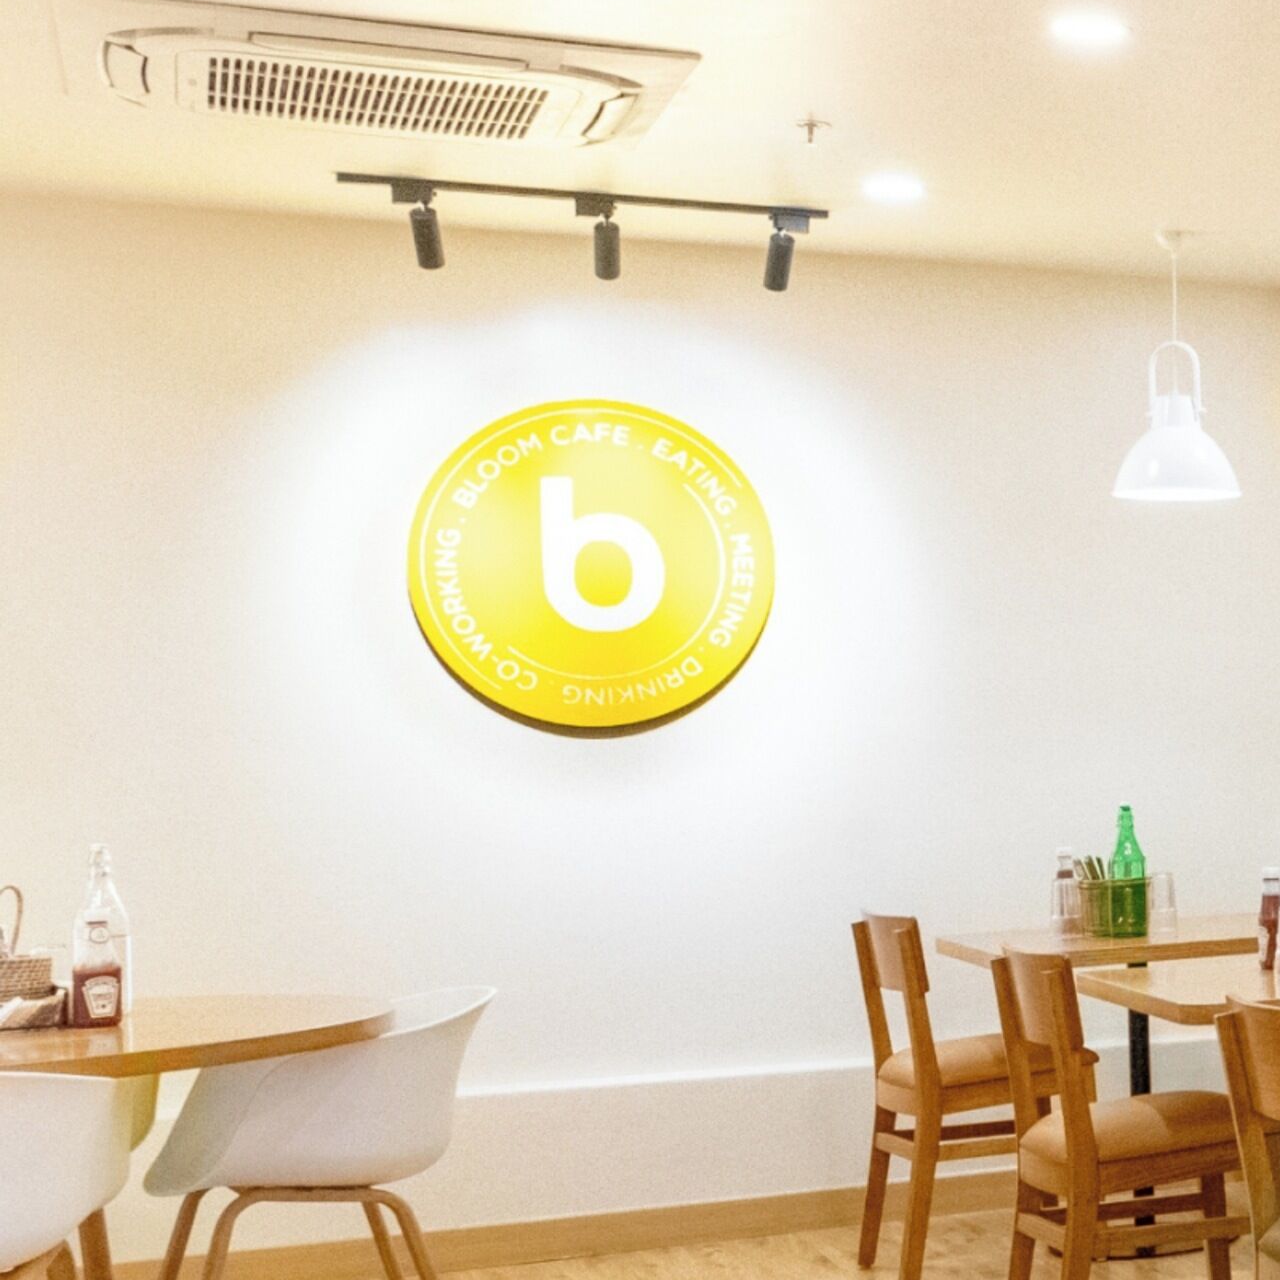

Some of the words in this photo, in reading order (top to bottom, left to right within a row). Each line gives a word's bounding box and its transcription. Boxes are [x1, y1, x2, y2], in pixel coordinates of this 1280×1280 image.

[452, 433, 543, 509] BLOOM
[550, 422, 632, 447] CAFE
[652, 438, 737, 516] EATING
[540, 476, 666, 633] b
[709, 533, 755, 648] MEETING
[434, 528, 539, 692] CO-WORKING
[562, 655, 704, 705] DRINKING
